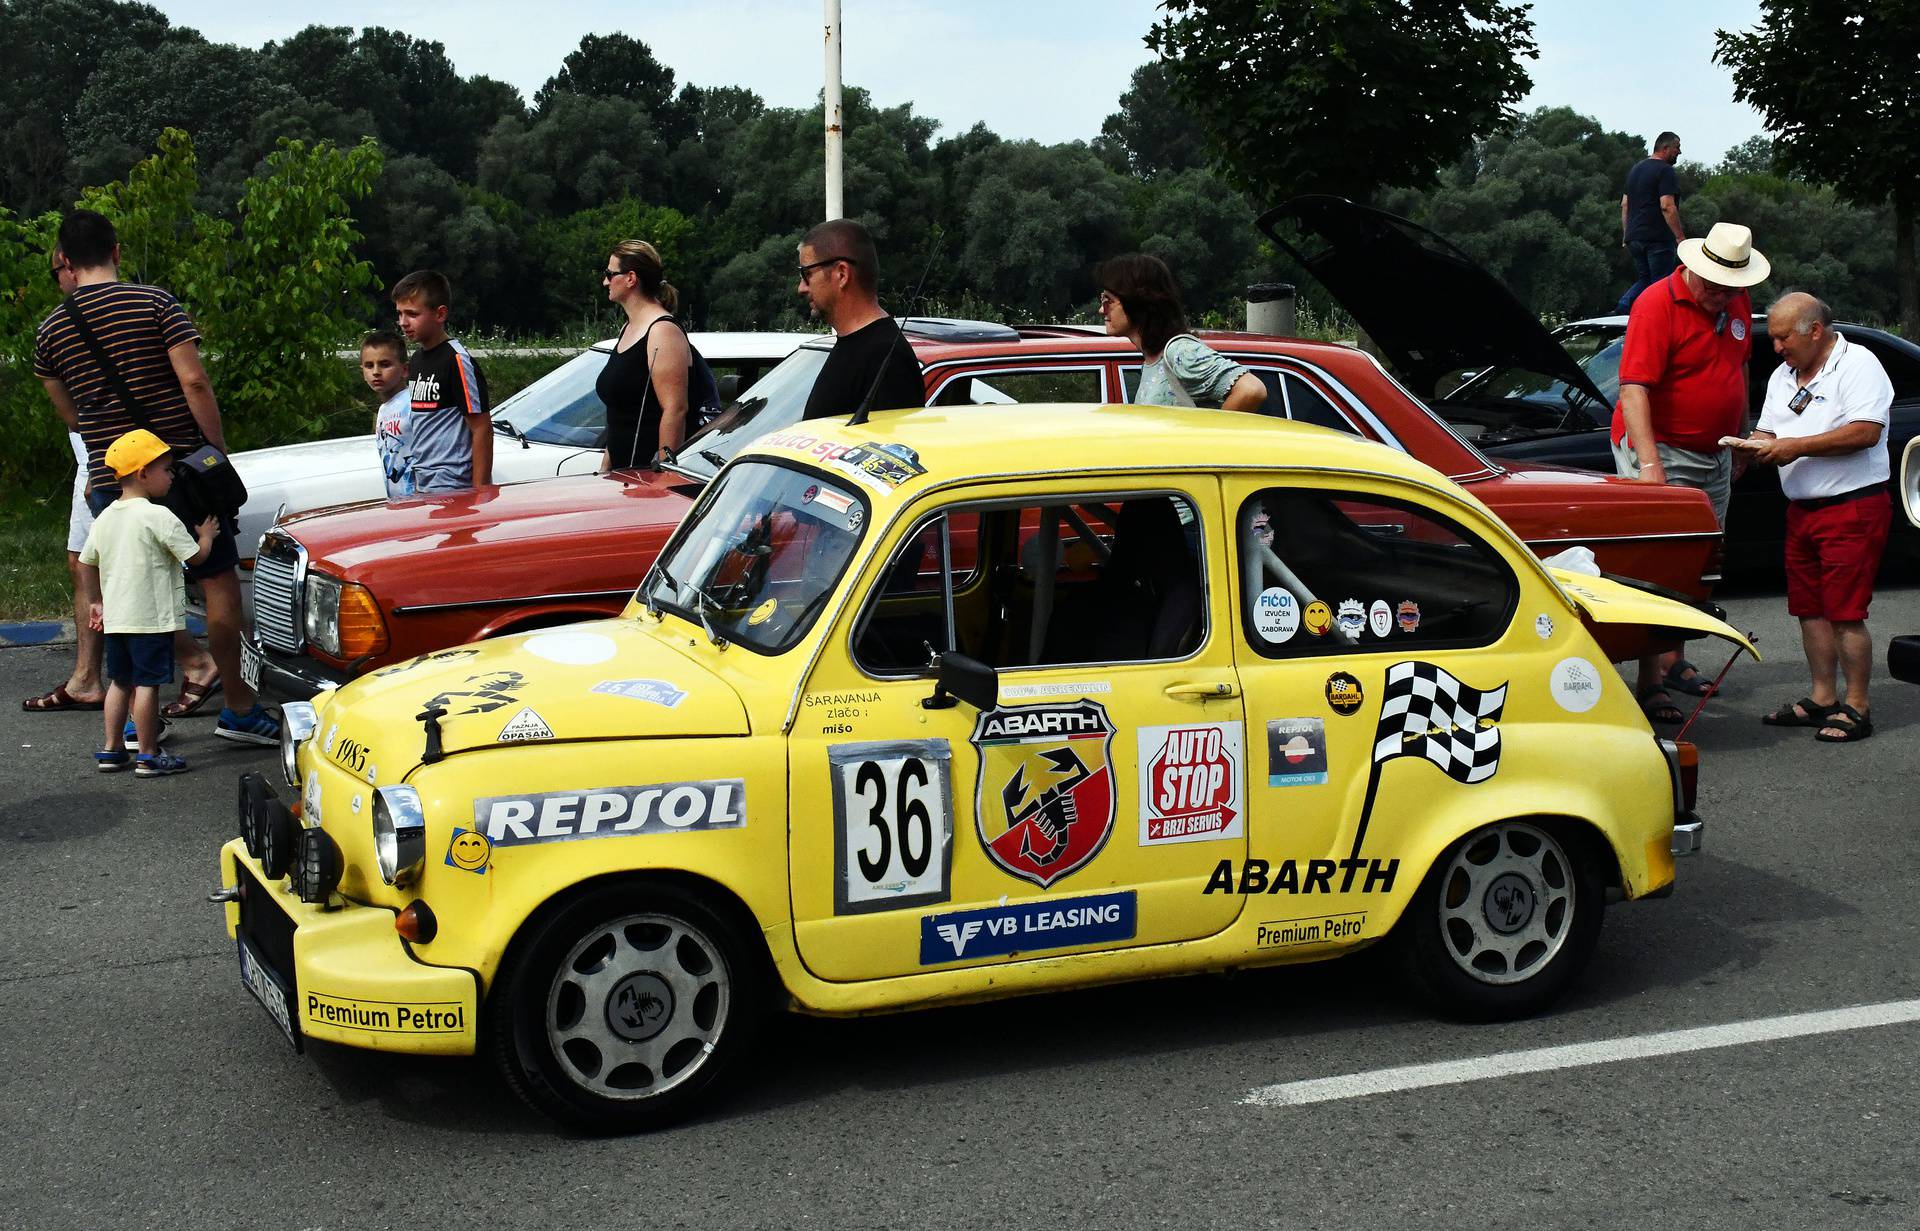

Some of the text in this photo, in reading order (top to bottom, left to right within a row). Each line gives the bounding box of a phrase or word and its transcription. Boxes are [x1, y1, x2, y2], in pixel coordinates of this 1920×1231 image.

[805, 692, 882, 707] ŠARAVANJA
[502, 730, 549, 740] OPASAN
[822, 723, 853, 735] mišo
[985, 712, 1098, 736] ABARTH
[335, 737, 370, 772] 1985
[1165, 729, 1222, 766] AUTO
[1160, 763, 1224, 811] STOP
[486, 784, 740, 841] REPSOL
[855, 757, 932, 883] 36
[1162, 812, 1223, 838] BRZI SERVIS
[1202, 858, 1401, 895] ABARTH
[986, 904, 1120, 937] VB LEASING
[1257, 923, 1319, 945] Premium
[308, 995, 464, 1029] Premium Petrol
